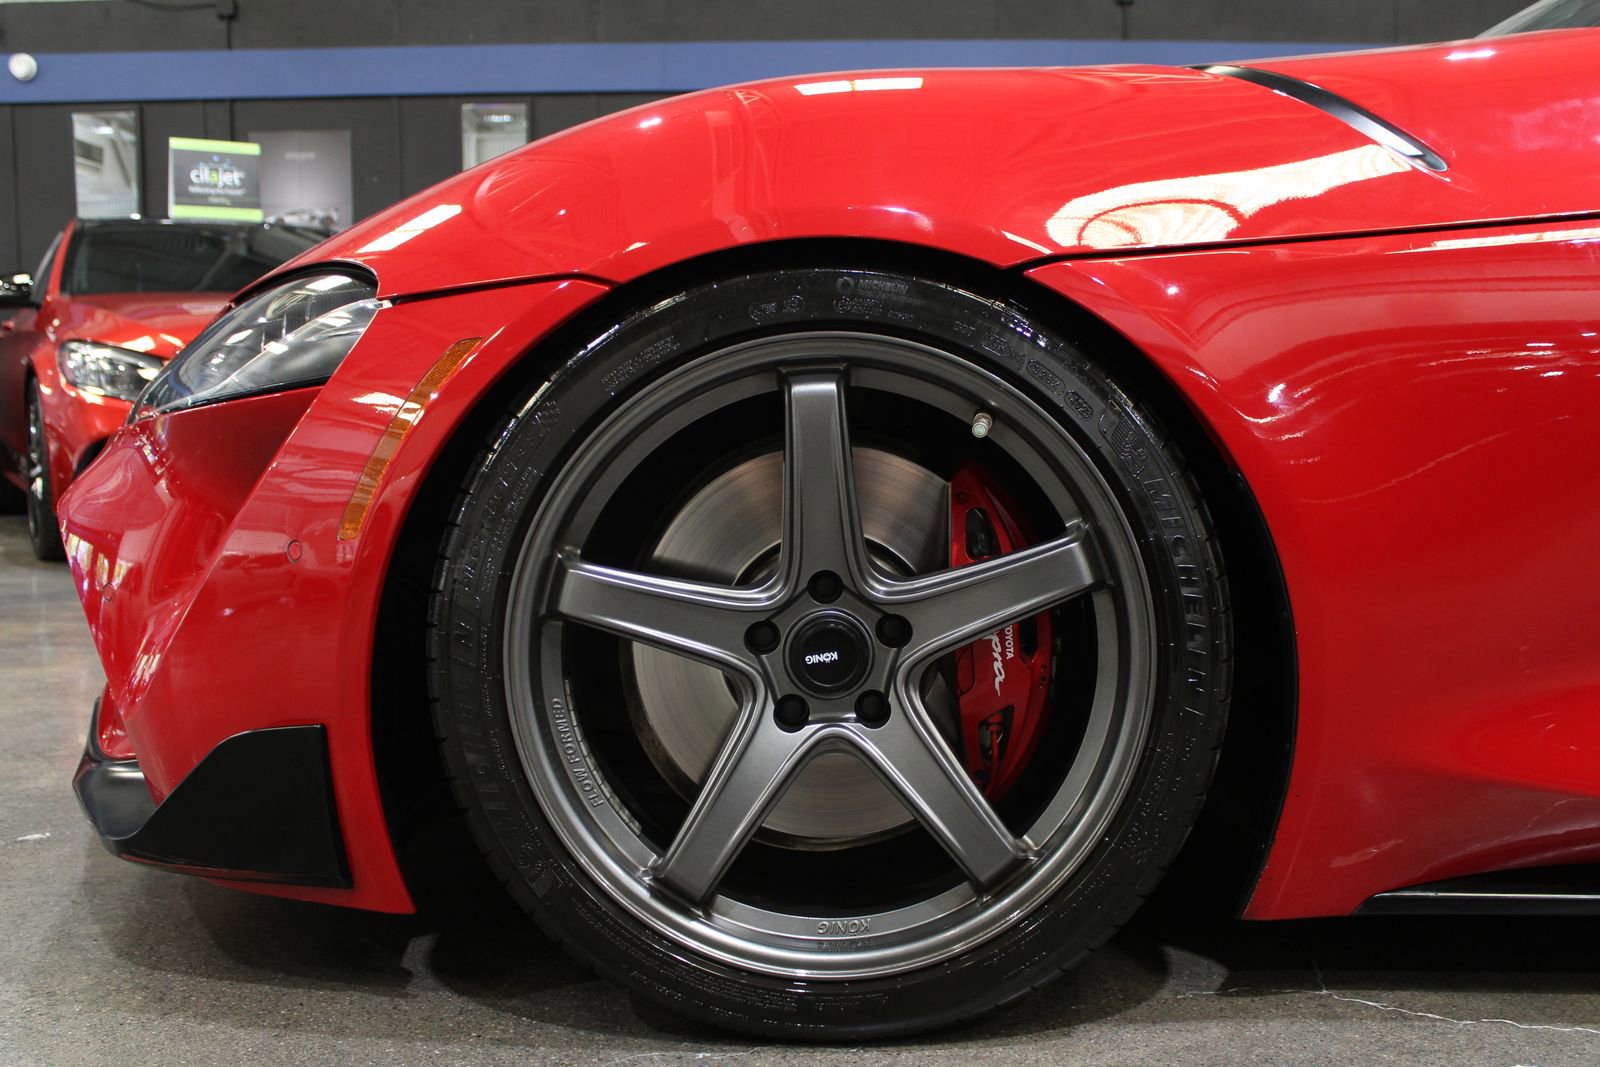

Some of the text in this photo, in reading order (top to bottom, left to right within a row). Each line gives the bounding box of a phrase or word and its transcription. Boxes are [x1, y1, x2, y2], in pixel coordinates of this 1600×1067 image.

[189, 165, 244, 188] cilajet
[1143, 477, 1207, 694] MICHELIN
[1004, 624, 1015, 660] OYOTA
[805, 651, 838, 664] KÖNIG
[551, 698, 604, 808] FLOW FORMED
[817, 918, 871, 936] KÖNIG
